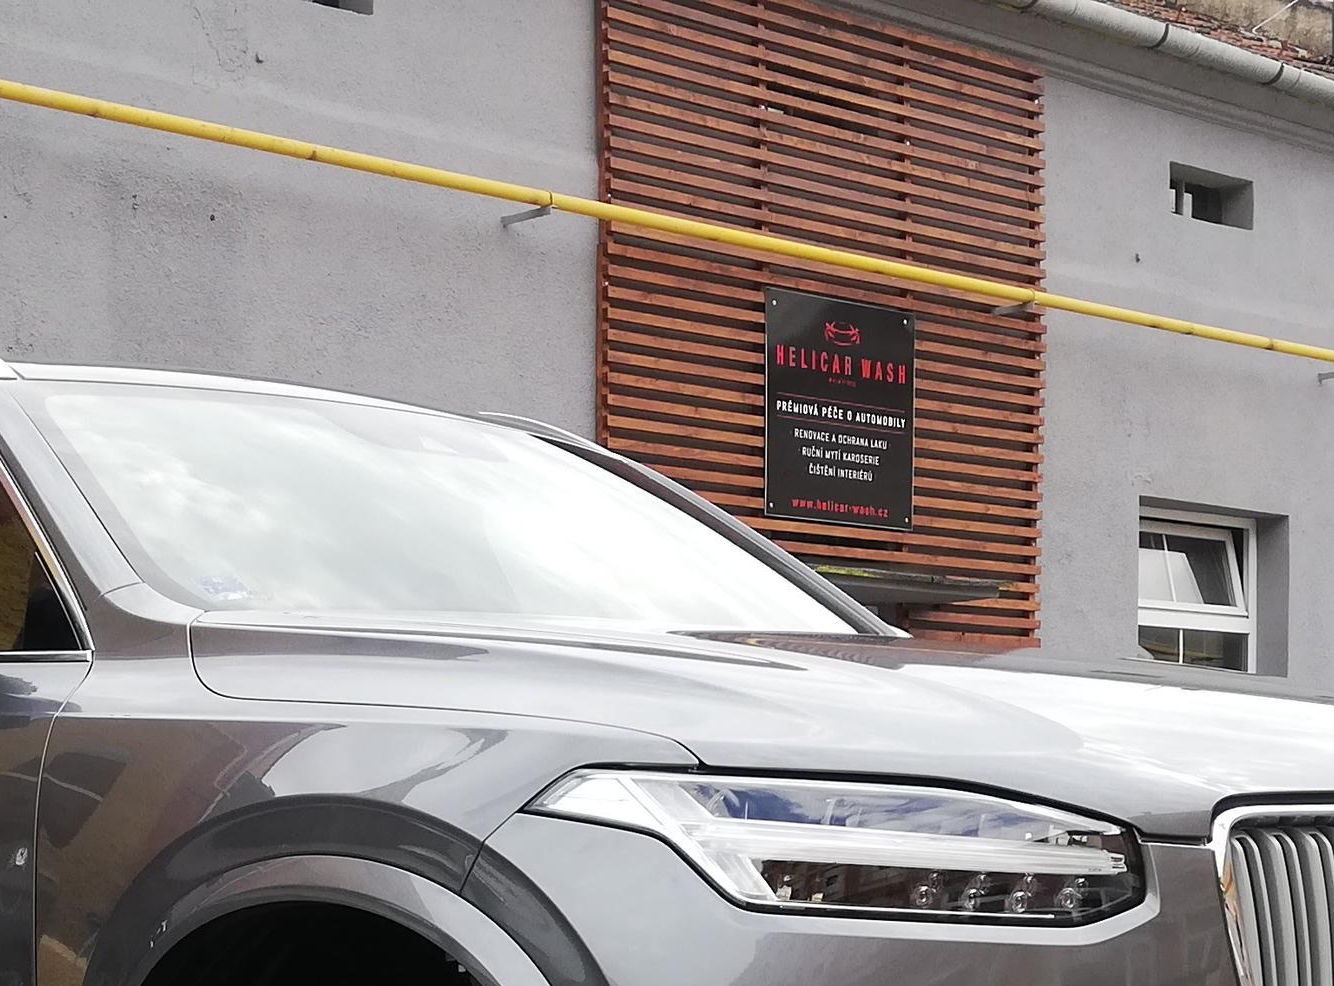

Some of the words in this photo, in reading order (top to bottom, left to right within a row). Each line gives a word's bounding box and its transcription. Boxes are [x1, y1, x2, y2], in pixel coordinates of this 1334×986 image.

[776, 344, 852, 376] HELICAR
[861, 358, 906, 384] WASH
[776, 400, 819, 416] PRÉMIOVÁ
[822, 405, 844, 420] PÉČE
[847, 410, 853, 421] O
[855, 412, 906, 429] AUTOMOBILY
[794, 428, 830, 442] RENOVACE
[831, 434, 837, 443] A
[838, 434, 869, 447] OCHRANA
[870, 438, 887, 450] LAKU
[802, 445, 823, 458] RUČNÍ
[825, 449, 841, 461] MYTÍ
[842, 452, 880, 466] KAROSERIE
[808, 462, 836, 477] ČIŠTĚNÍ
[837, 468, 873, 482] INTERIÉRŮ
[791, 499, 889, 518] www.helicar-wash.cz
